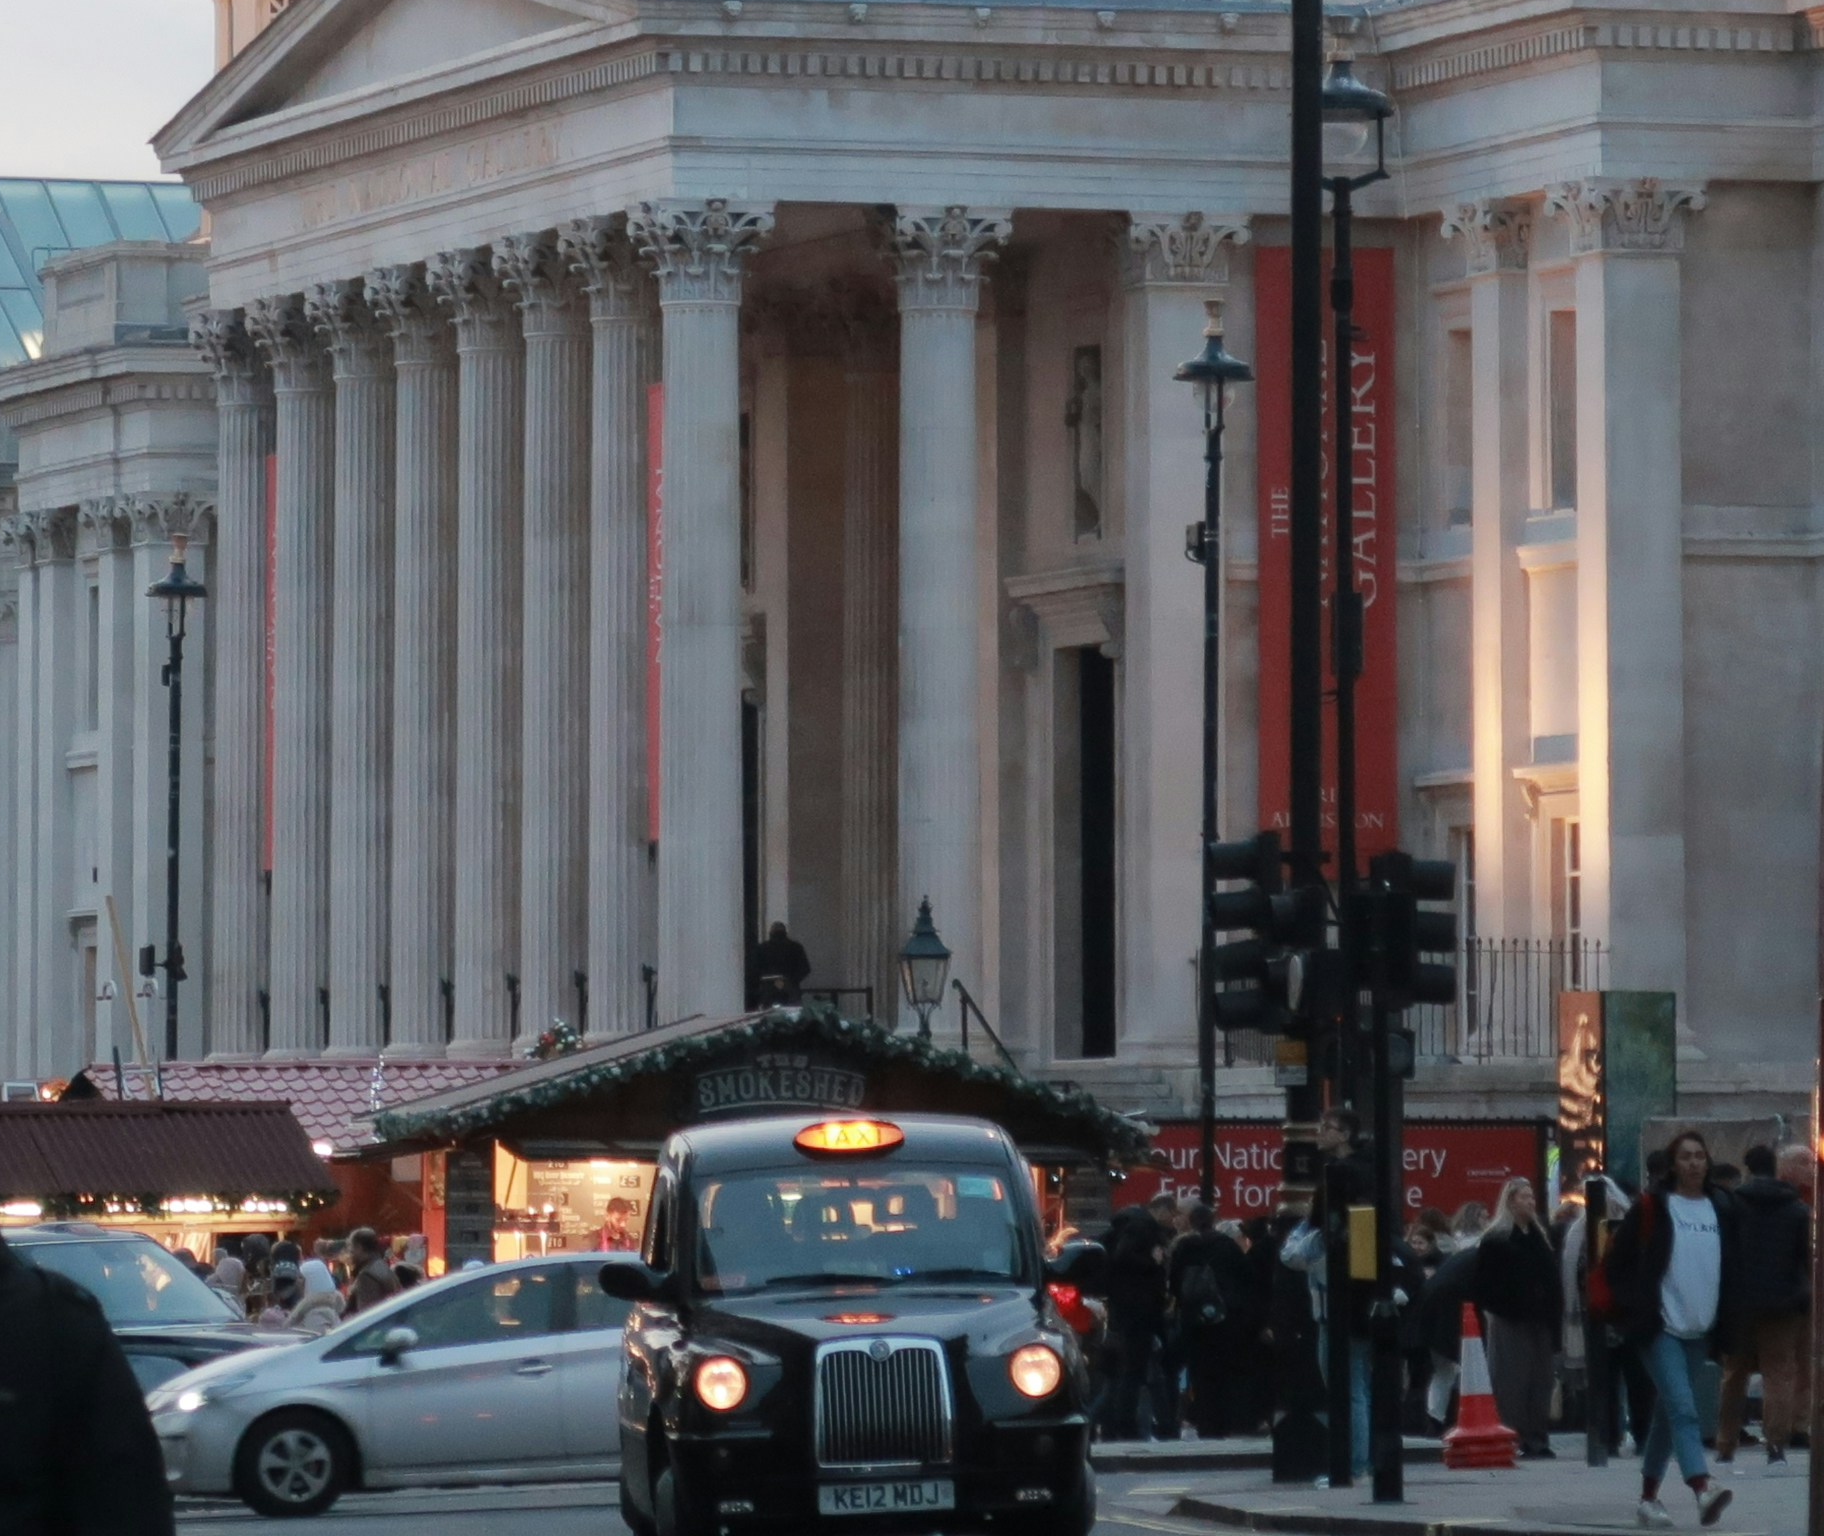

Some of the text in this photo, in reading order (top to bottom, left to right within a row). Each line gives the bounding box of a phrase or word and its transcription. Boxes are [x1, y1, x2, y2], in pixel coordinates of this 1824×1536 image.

[1271, 486, 1289, 538] THE
[697, 1070, 865, 1107] SMOKESHED
[819, 1127, 882, 1145] TAXI
[1232, 1177, 1275, 1208] for
[833, 1482, 939, 1510] KE12 MDJ
